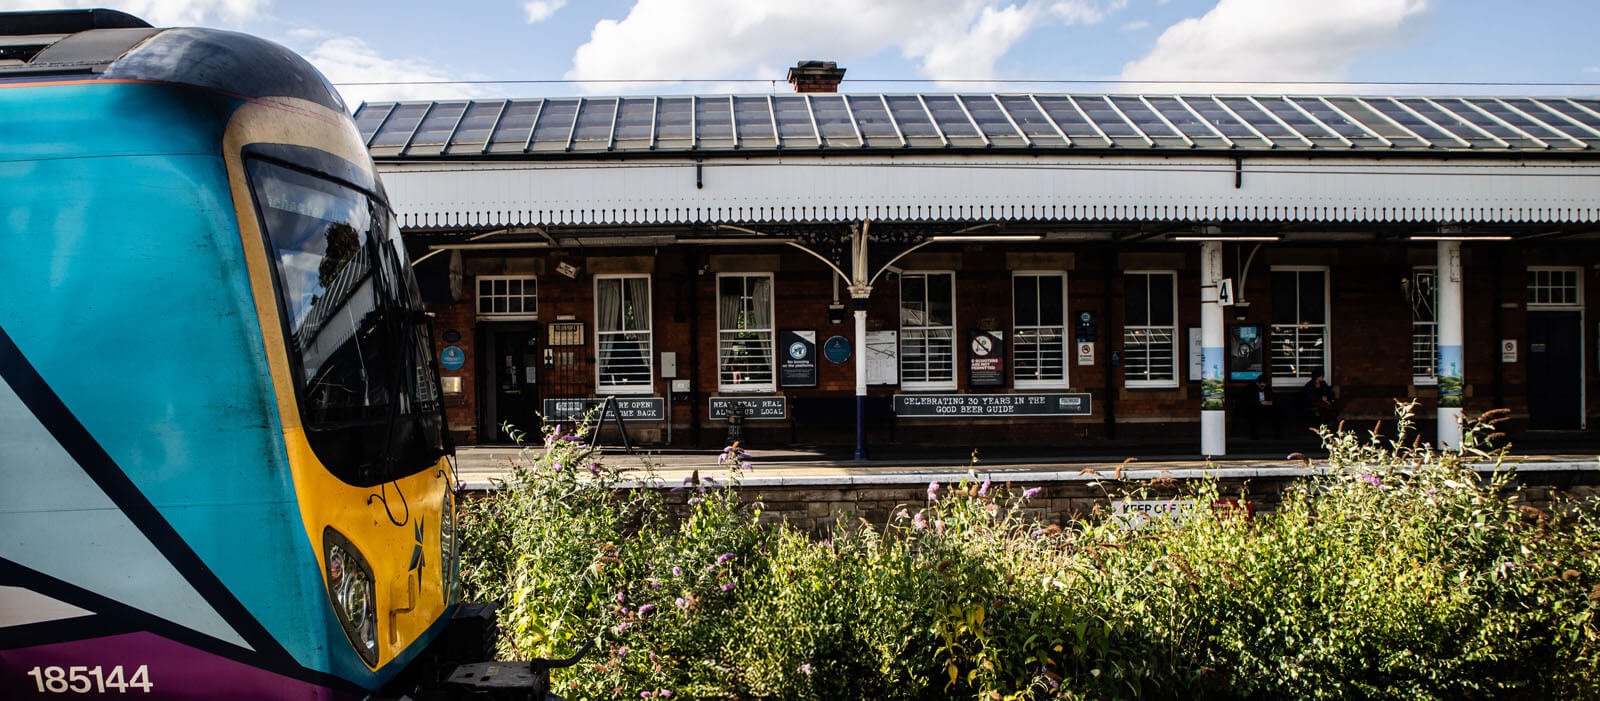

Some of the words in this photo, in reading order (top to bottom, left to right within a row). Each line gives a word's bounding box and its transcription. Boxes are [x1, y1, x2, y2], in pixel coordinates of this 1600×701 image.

[1220, 281, 1228, 303] 4
[762, 400, 782, 408] REAL
[903, 397, 964, 405] CELEBRATING
[968, 397, 979, 405] 30
[982, 397, 1011, 405] YEARS
[1014, 396, 1025, 404] IN
[1028, 396, 1046, 404] THE
[637, 409, 657, 417] BACK
[936, 405, 957, 413] GOOD
[960, 405, 983, 413] BEER
[986, 405, 1014, 413] GUIDE
[27, 665, 154, 693] 185144
